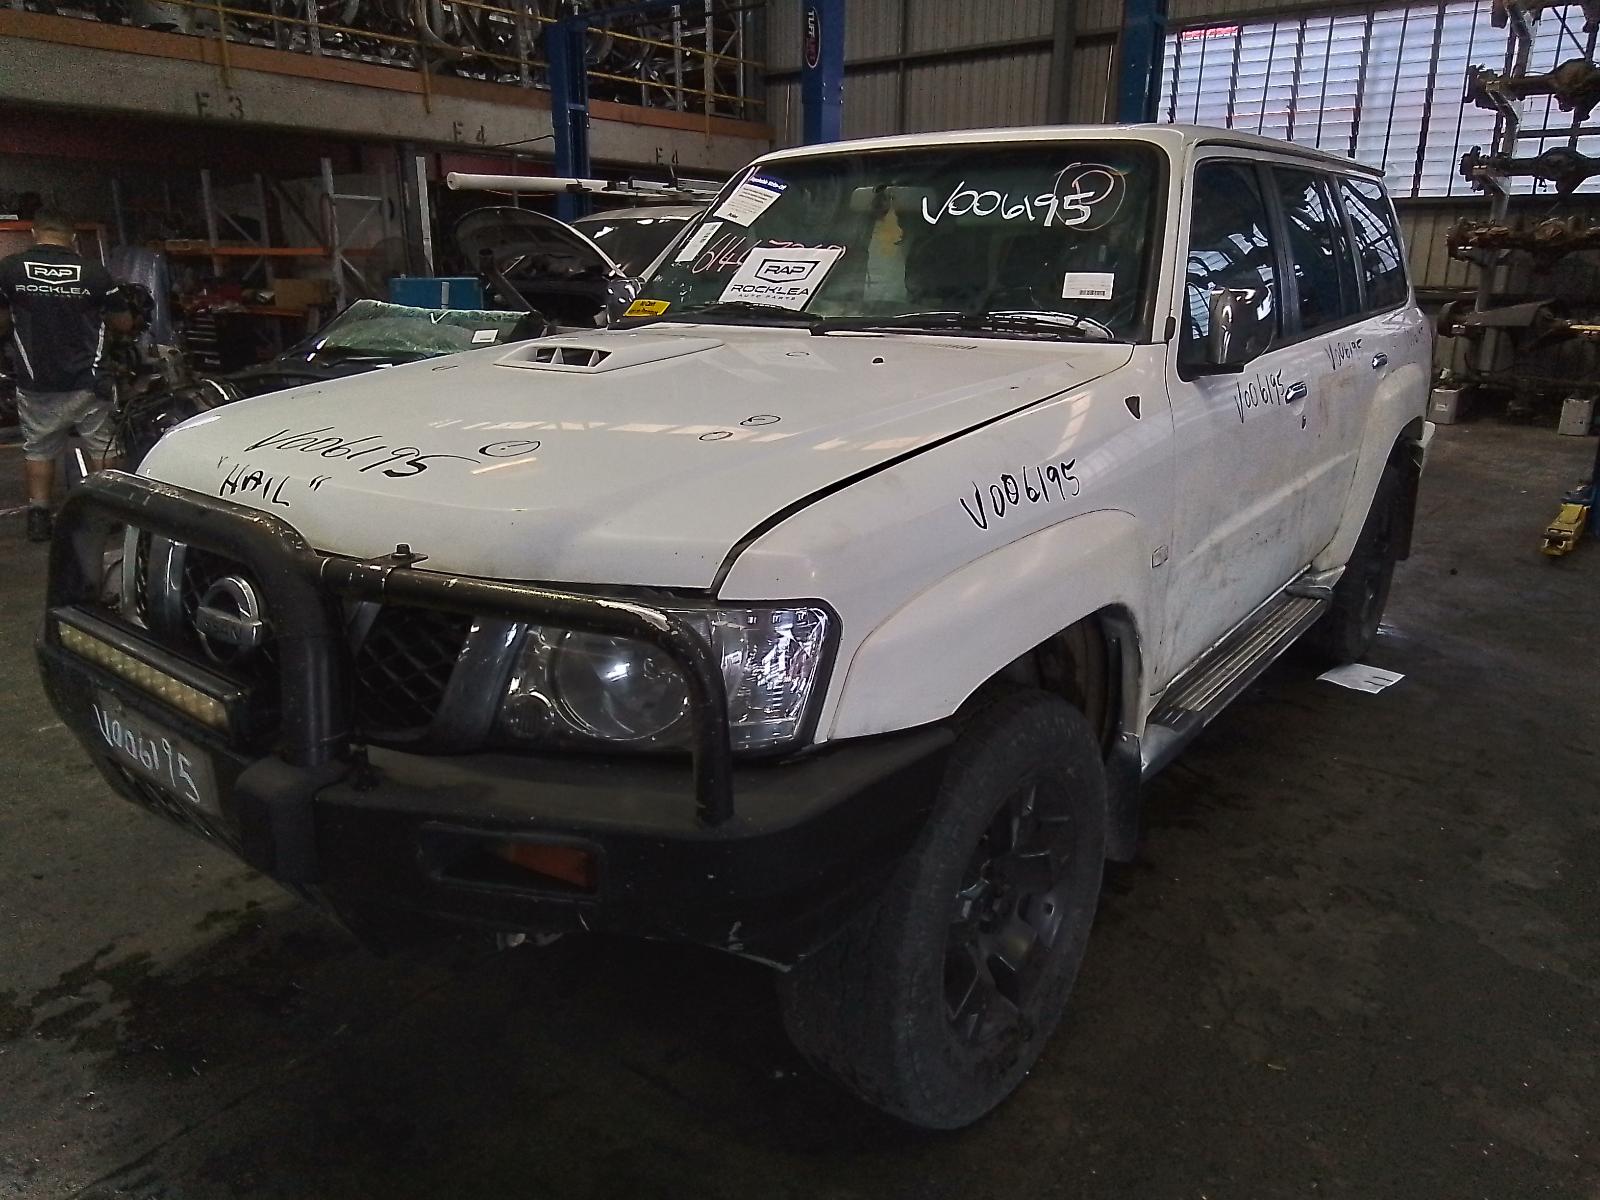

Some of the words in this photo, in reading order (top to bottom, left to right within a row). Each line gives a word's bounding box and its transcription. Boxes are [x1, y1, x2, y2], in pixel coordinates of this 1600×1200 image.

[228, 95, 244, 119] 3
[922, 181, 1095, 226] V006195
[34, 267, 73, 277] RAP
[763, 265, 806, 275] RAP
[15, 284, 91, 296] ROCKLEA
[730, 284, 810, 297] ROCKLEA
[1234, 369, 1286, 424] V006195
[244, 426, 481, 478] V006195
[959, 458, 1081, 530] V006195
[92, 703, 201, 804] V006195
